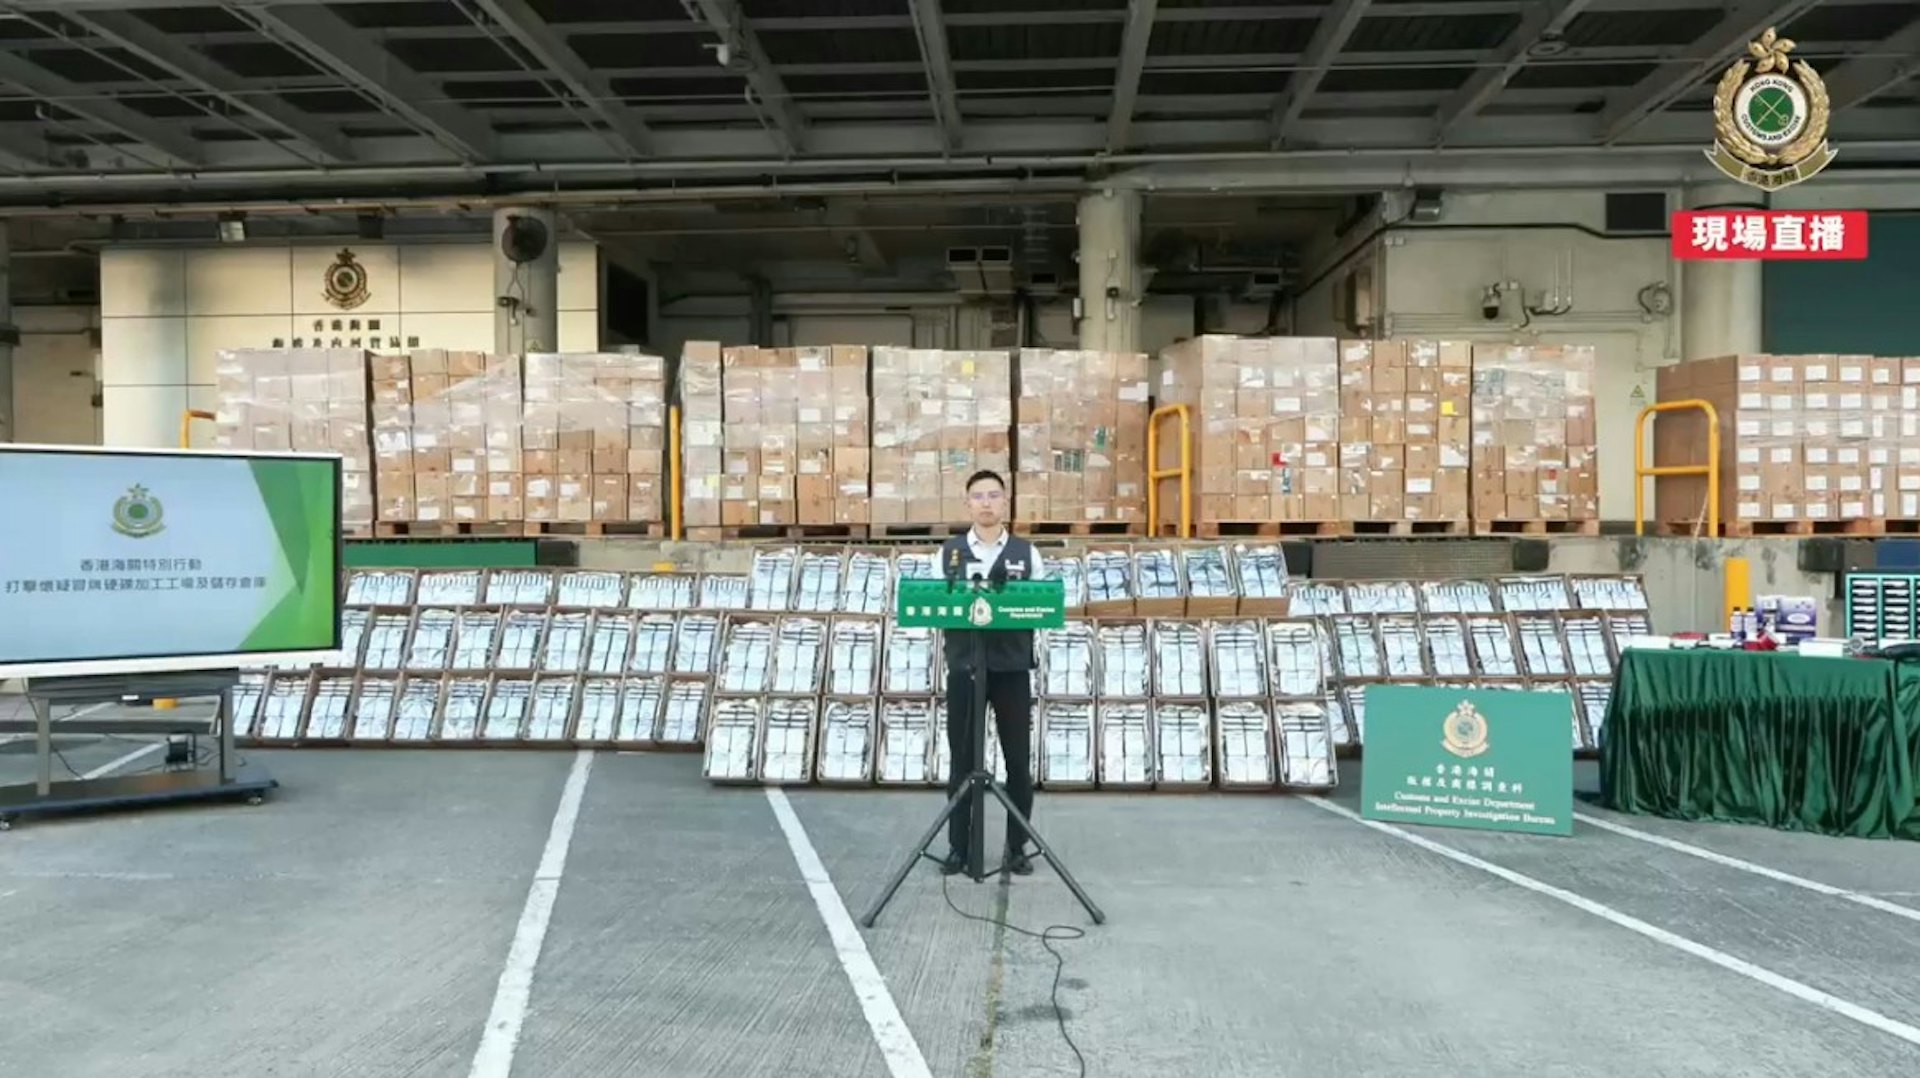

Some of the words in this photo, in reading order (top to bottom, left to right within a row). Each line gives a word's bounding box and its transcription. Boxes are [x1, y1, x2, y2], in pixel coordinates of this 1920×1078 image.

[80, 558, 202, 572] 香港海關特別行動
[1436, 763, 1495, 778] 香港海關
[1394, 791, 1431, 802] Customs
[1433, 794, 1450, 804] and
[1452, 795, 1480, 806] Excise
[1483, 798, 1536, 811] Department
[1375, 802, 1422, 814] Intellectual
[1424, 805, 1461, 818] Property
[1464, 810, 1520, 823] Investigation
[1523, 813, 1556, 825] Bureau
